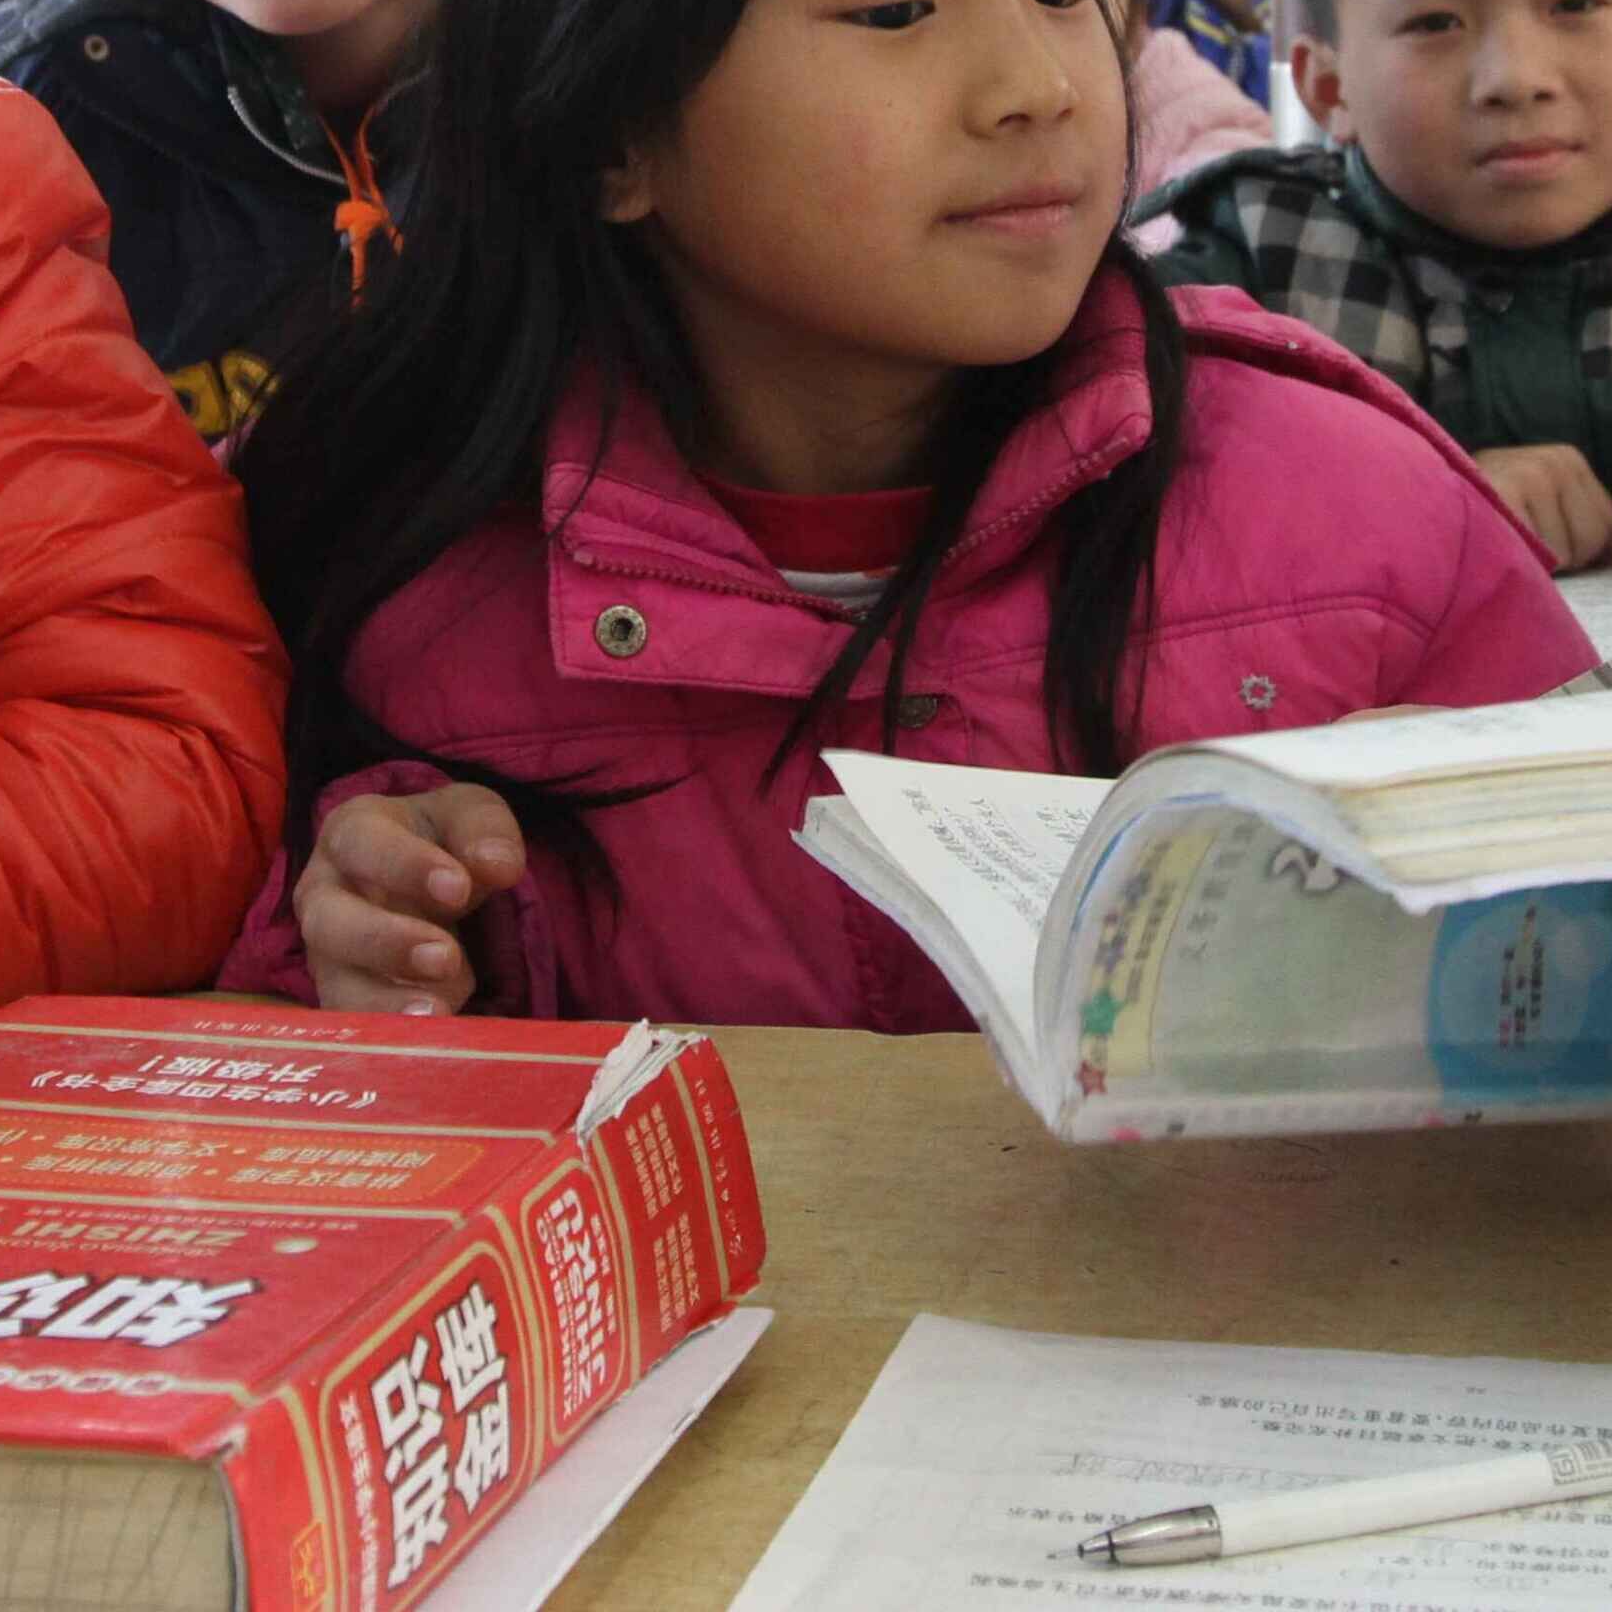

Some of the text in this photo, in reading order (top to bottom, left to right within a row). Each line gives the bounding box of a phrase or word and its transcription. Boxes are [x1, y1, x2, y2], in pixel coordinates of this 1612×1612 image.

[15, 1216, 248, 1251] ZHISHI
[371, 1334, 450, 1592] 知识
[434, 1283, 509, 1515] 金库
